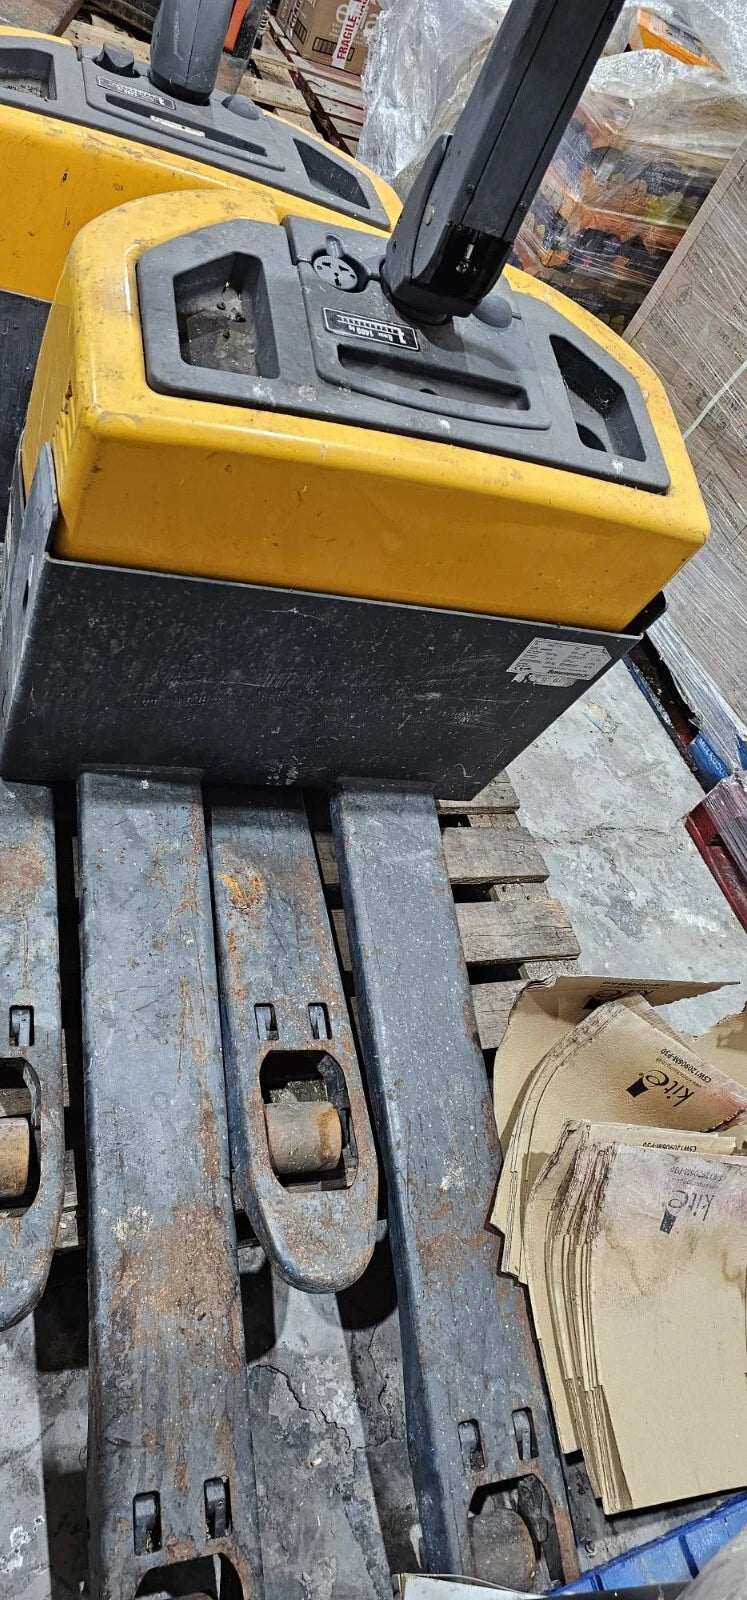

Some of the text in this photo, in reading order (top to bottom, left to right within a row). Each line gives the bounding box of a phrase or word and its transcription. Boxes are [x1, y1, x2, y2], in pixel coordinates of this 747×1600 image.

[336, 15, 358, 60] FRAGILE
[356, 327, 374, 337] 1400
[643, 1069, 695, 1108] kite
[667, 1189, 715, 1222] kite
